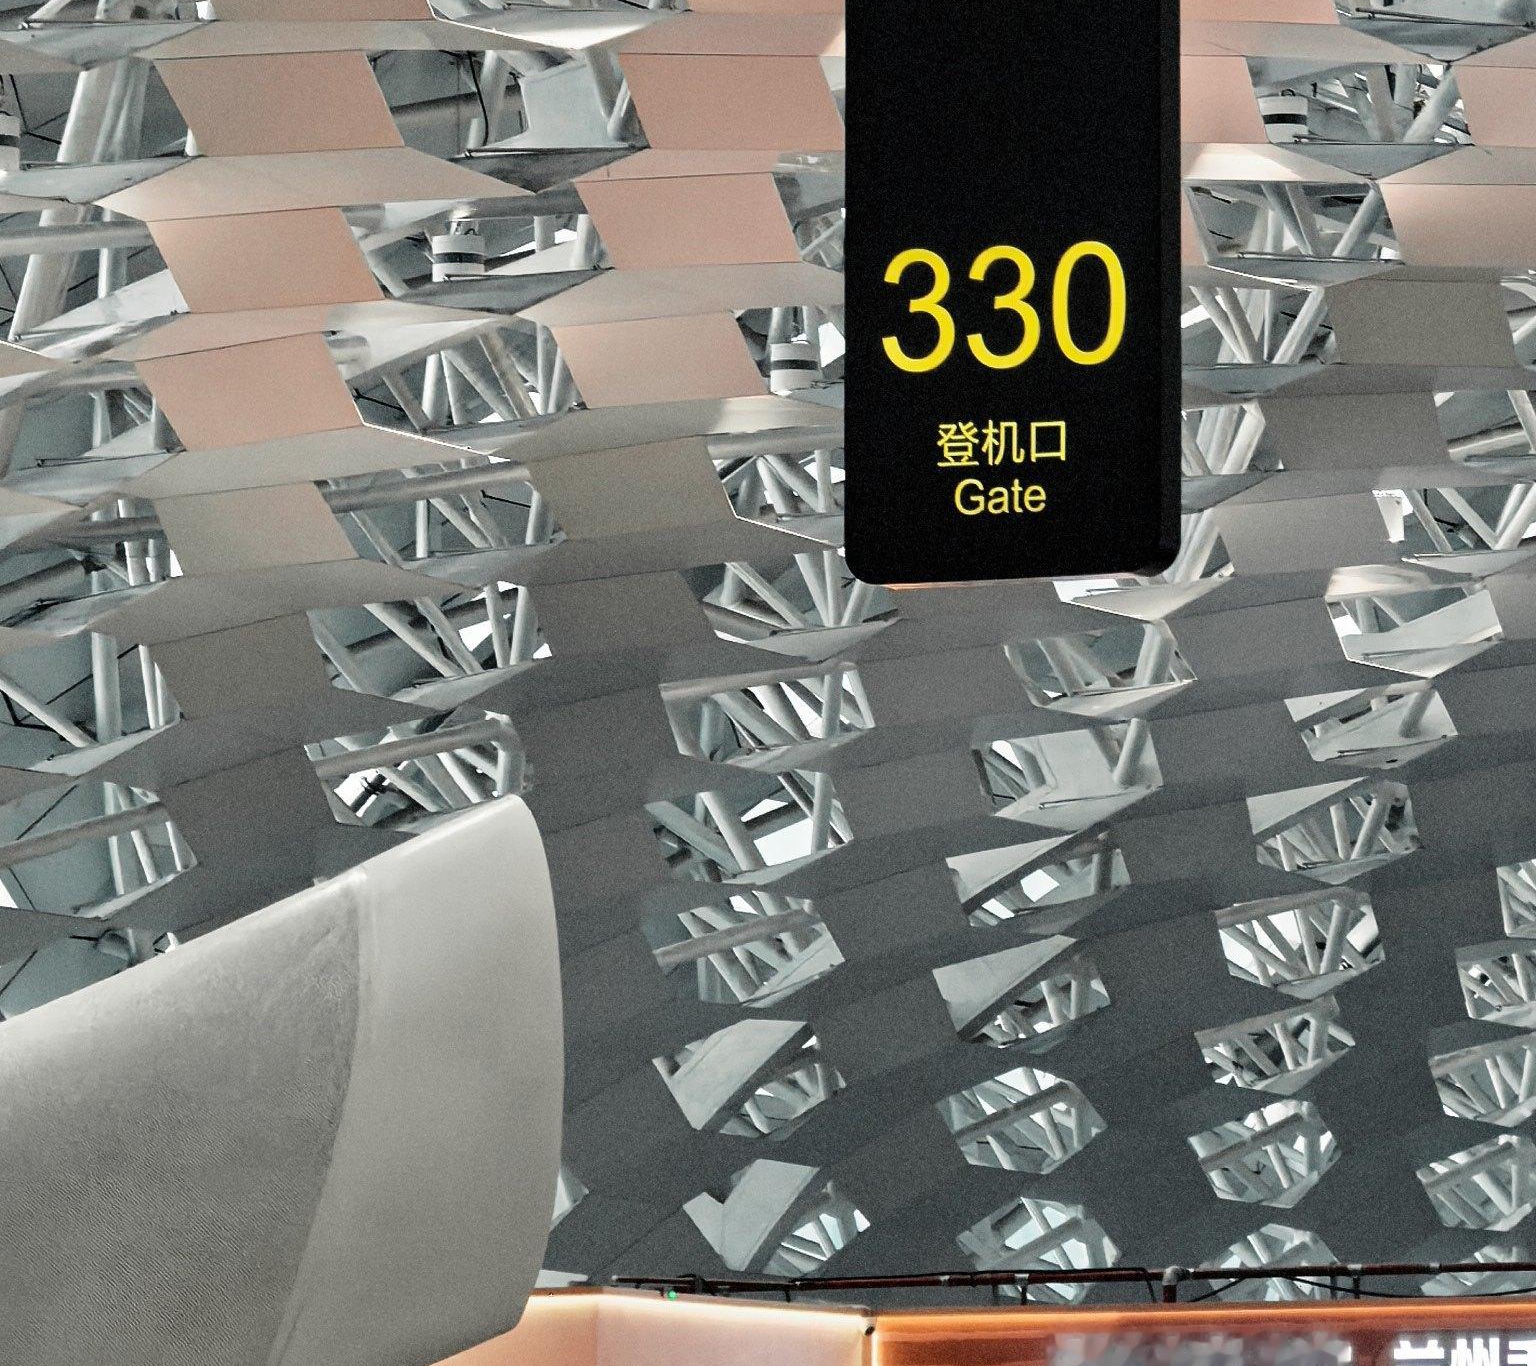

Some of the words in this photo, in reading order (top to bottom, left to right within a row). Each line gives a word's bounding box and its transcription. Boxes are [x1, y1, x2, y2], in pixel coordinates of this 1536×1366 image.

[882, 241, 1127, 373] 330
[937, 420, 1067, 467] 登机口
[954, 478, 1047, 516] Gate
